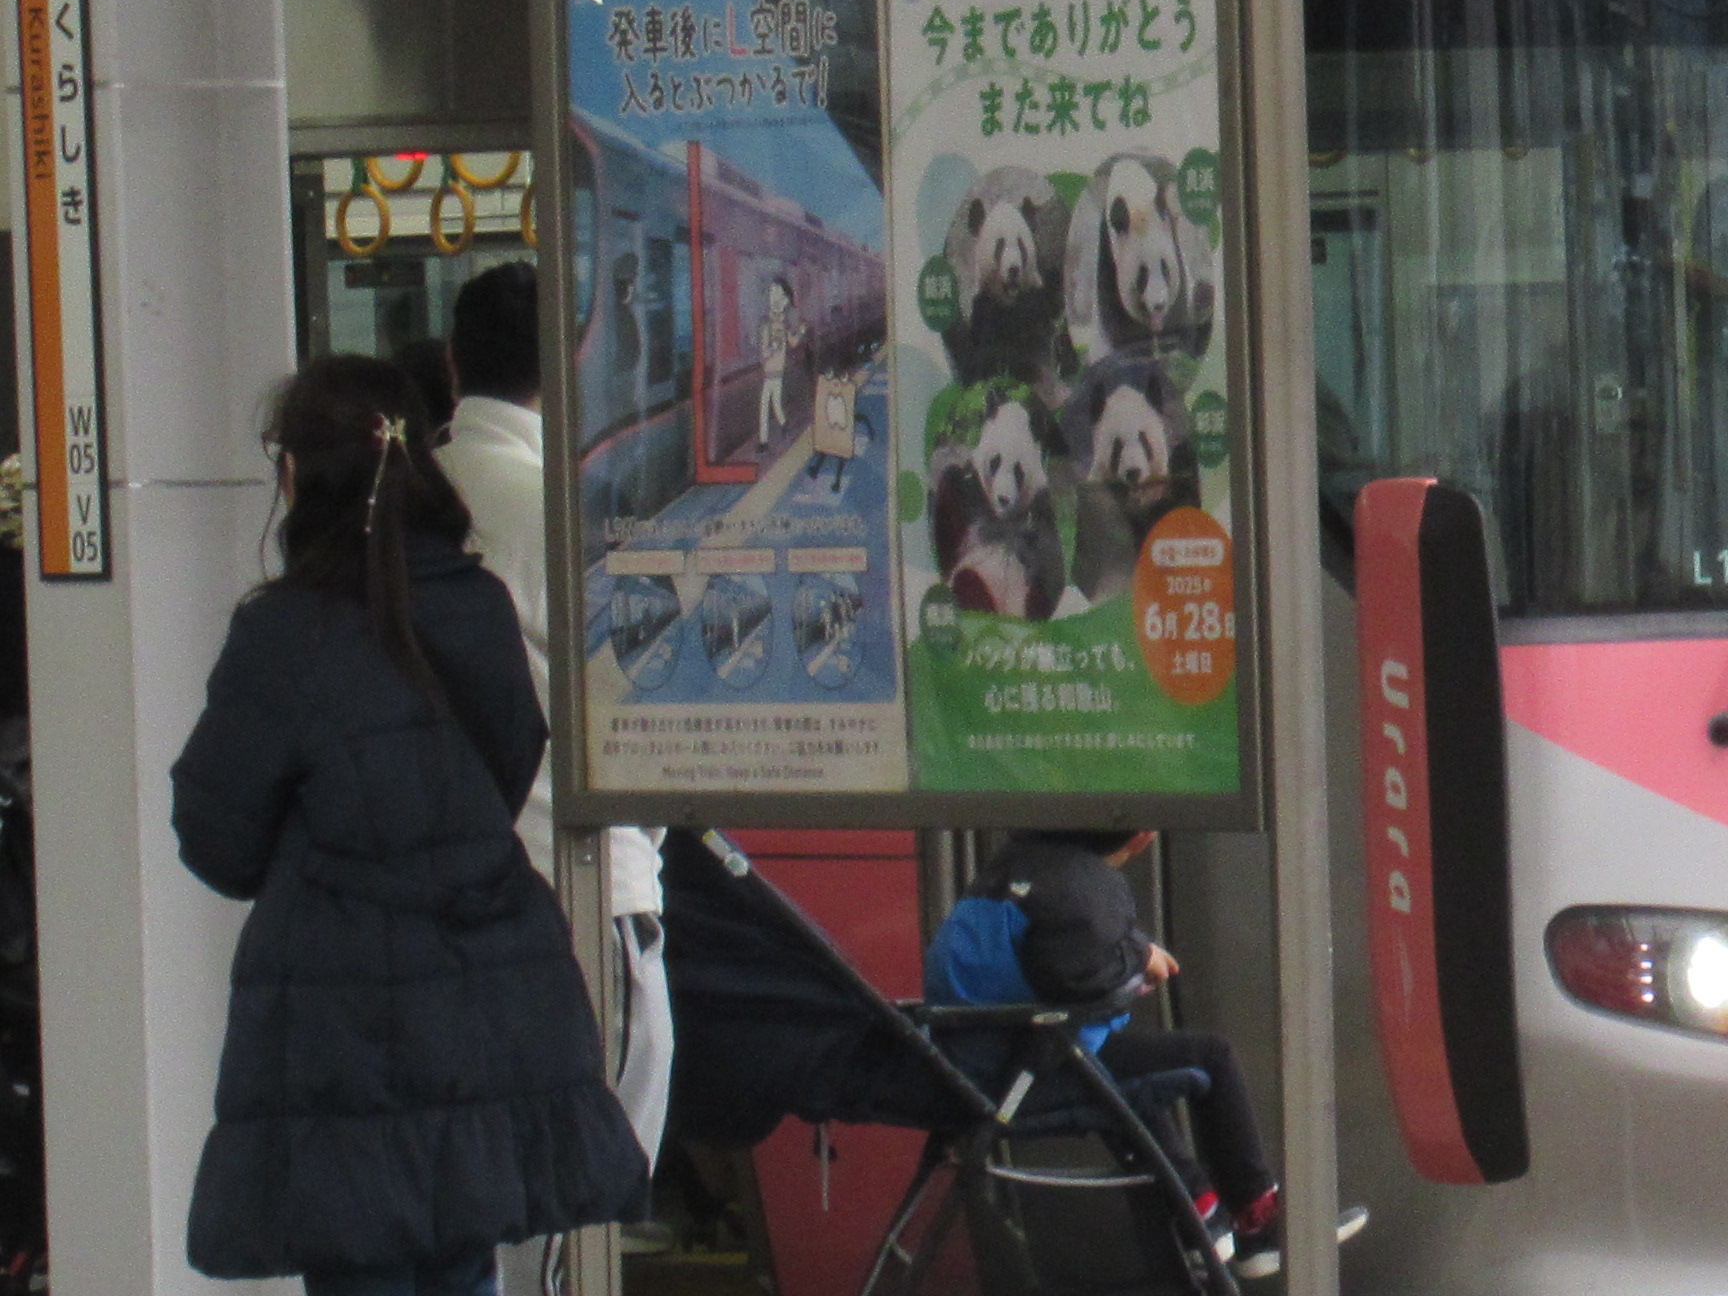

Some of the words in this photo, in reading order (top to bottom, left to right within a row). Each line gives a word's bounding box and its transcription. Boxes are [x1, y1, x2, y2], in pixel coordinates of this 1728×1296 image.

[28, 7, 51, 179] Kurashiki
[55, 1, 85, 226] くらしき
[978, 73, 1152, 137] また来てね
[69, 405, 92, 437] W
[69, 443, 95, 475] 05
[76, 493, 92, 526] V
[72, 531, 98, 562] 05
[1380, 658, 1412, 914] Urara
